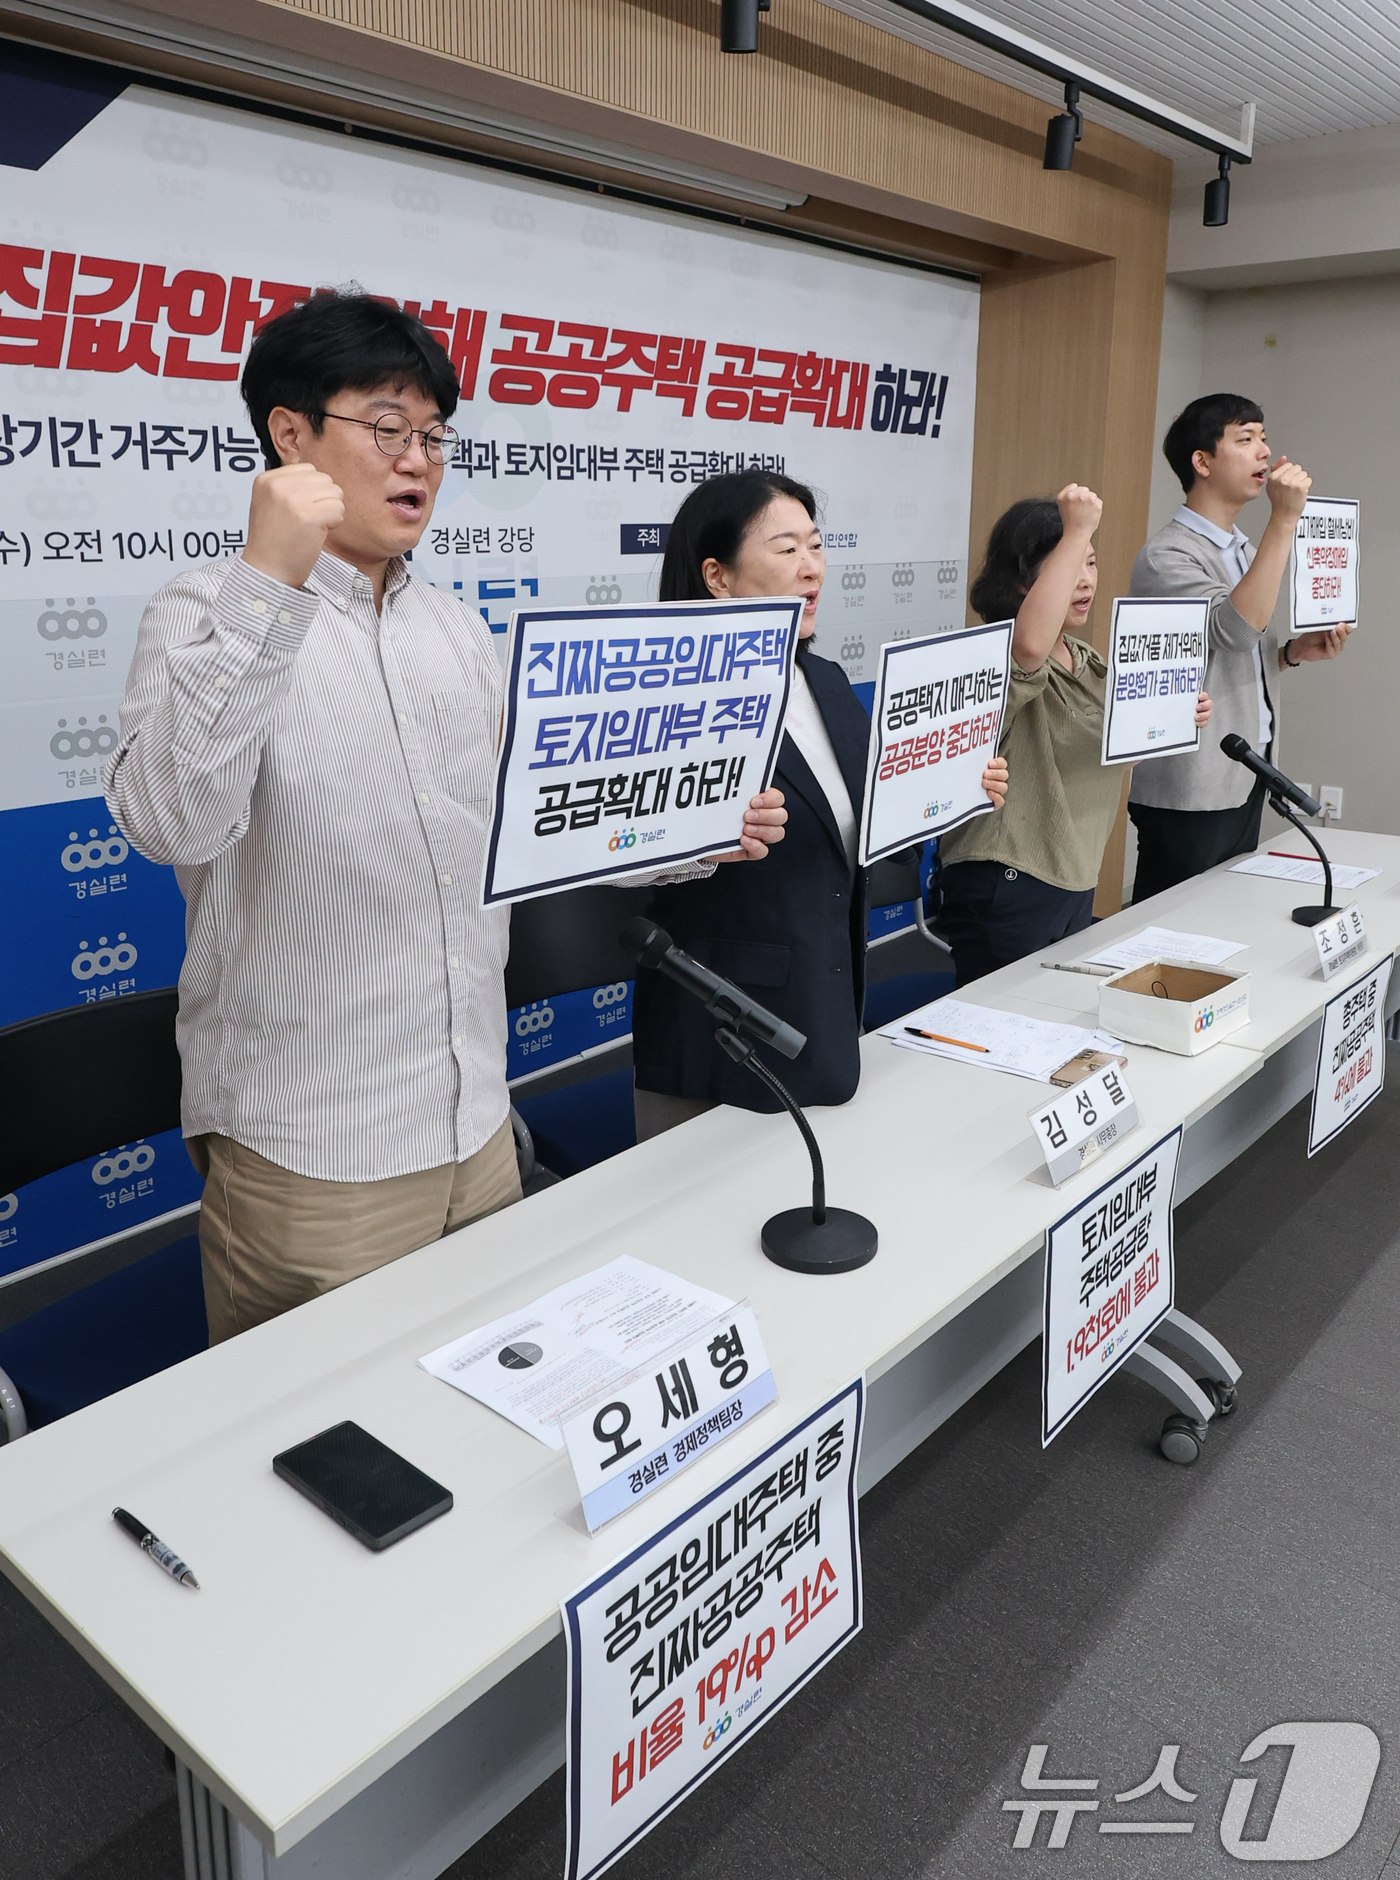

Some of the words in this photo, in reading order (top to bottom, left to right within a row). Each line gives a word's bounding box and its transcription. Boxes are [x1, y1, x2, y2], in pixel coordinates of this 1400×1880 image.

[365, 294, 487, 401] 해
[488, 313, 707, 418] 공공주택
[705, 342, 870, 431] 공급확대
[870, 363, 949, 439] 하라!
[110, 421, 270, 472] 거주가능
[449, 439, 500, 479] 택과
[504, 442, 620, 482] 토지임대부
[623, 448, 664, 483] 주택
[668, 450, 745, 484] 공급확대
[42, 529, 104, 563] 오전
[111, 528, 174, 561] 10시
[183, 529, 247, 558] 00분
[430, 526, 491, 555] 경실련
[497, 527, 535, 553] 강당
[637, 527, 661, 547] 주최
[819, 533, 858, 549] 시민연합
[45, 649, 107, 671] 경실련
[526, 628, 788, 699] 진짜공공임대주택
[1118, 633, 1162, 663] 집값거품
[1162, 631, 1203, 661] 제거위해
[886, 679, 950, 732] 공공택지
[950, 667, 1003, 712] 매각하는
[1115, 670, 1159, 702] 분양원가
[528, 701, 706, 770] 토지임대부
[708, 694, 772, 744] 주택
[879, 728, 946, 782] 공공분양
[946, 709, 1001, 760] 중단하라!
[534, 767, 673, 837] 공급확대
[675, 756, 747, 809] 하라!
[640, 828, 667, 843] 경실련
[69, 872, 129, 899] 경실련
[79, 978, 137, 1004] 경실련
[595, 1006, 626, 1027] 경실련
[1368, 978, 1377, 1009] 중
[519, 1034, 552, 1056] 경실련
[99, 1177, 155, 1209] 경실련
[1081, 1162, 1158, 1263] 토지임대부
[1079, 1210, 1153, 1309] 주택공급량
[1065, 1277, 1132, 1375] 1.9천호에
[1133, 1247, 1160, 1308] 불과
[627, 1452, 670, 1494] 경실련
[672, 1399, 744, 1463] 경제정책팀장
[603, 1446, 809, 1663] 공공임대주택
[814, 1418, 844, 1482] 중
[630, 1496, 822, 1719] 진짜공공주택
[611, 1697, 686, 1807] 비율
[780, 1557, 839, 1645] 감소
[735, 1687, 763, 1718] 경실련
